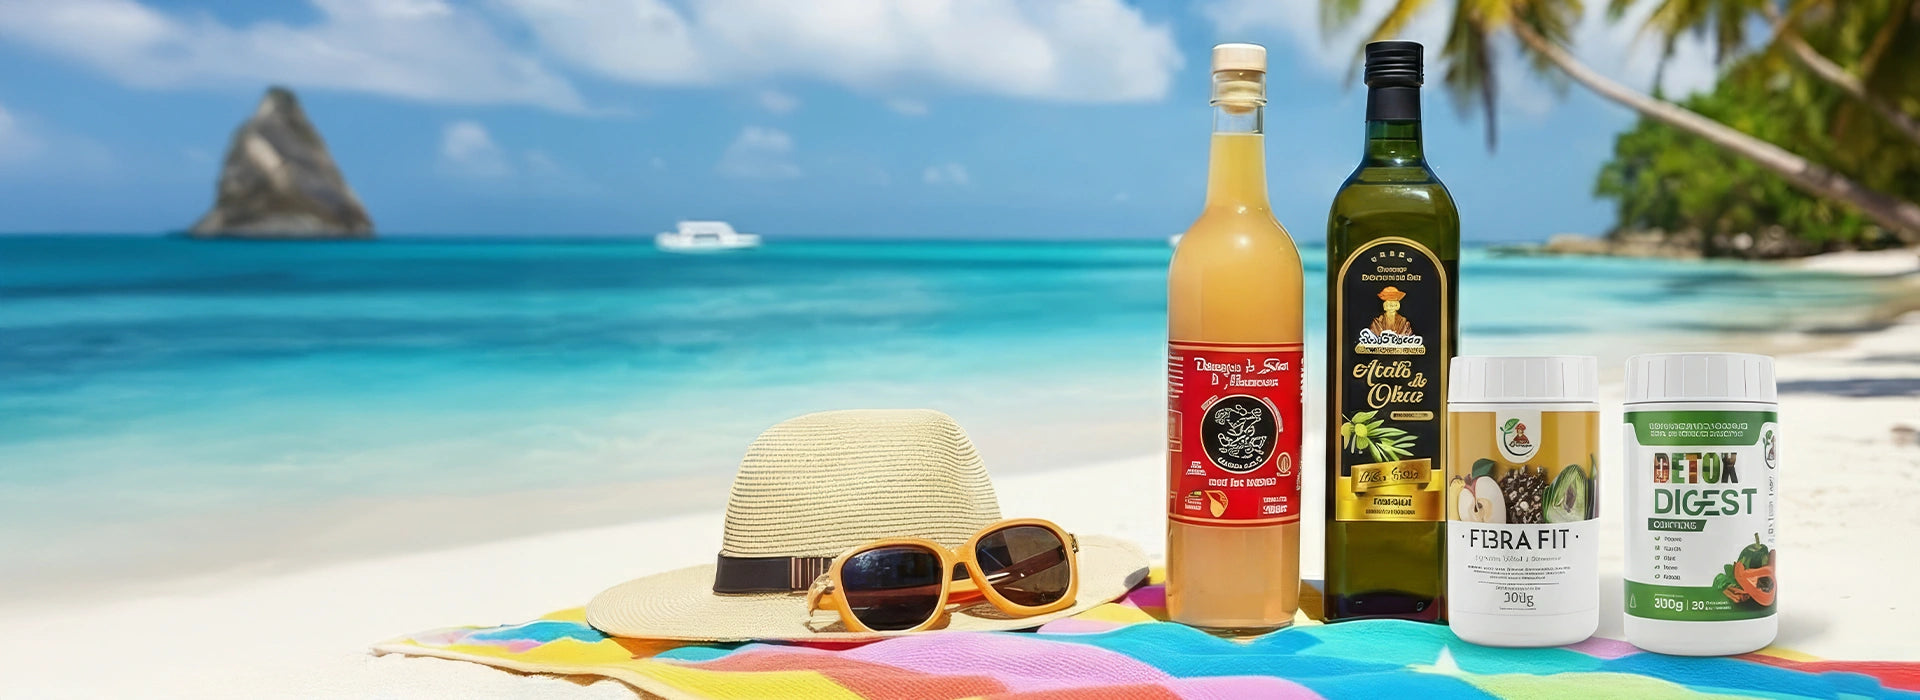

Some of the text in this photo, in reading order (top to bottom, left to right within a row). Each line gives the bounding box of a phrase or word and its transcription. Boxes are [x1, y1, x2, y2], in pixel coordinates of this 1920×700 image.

[1653, 452, 1739, 484] DETOX
[1654, 488, 1758, 516] DIGEST
[1538, 528, 1570, 549] FIT
